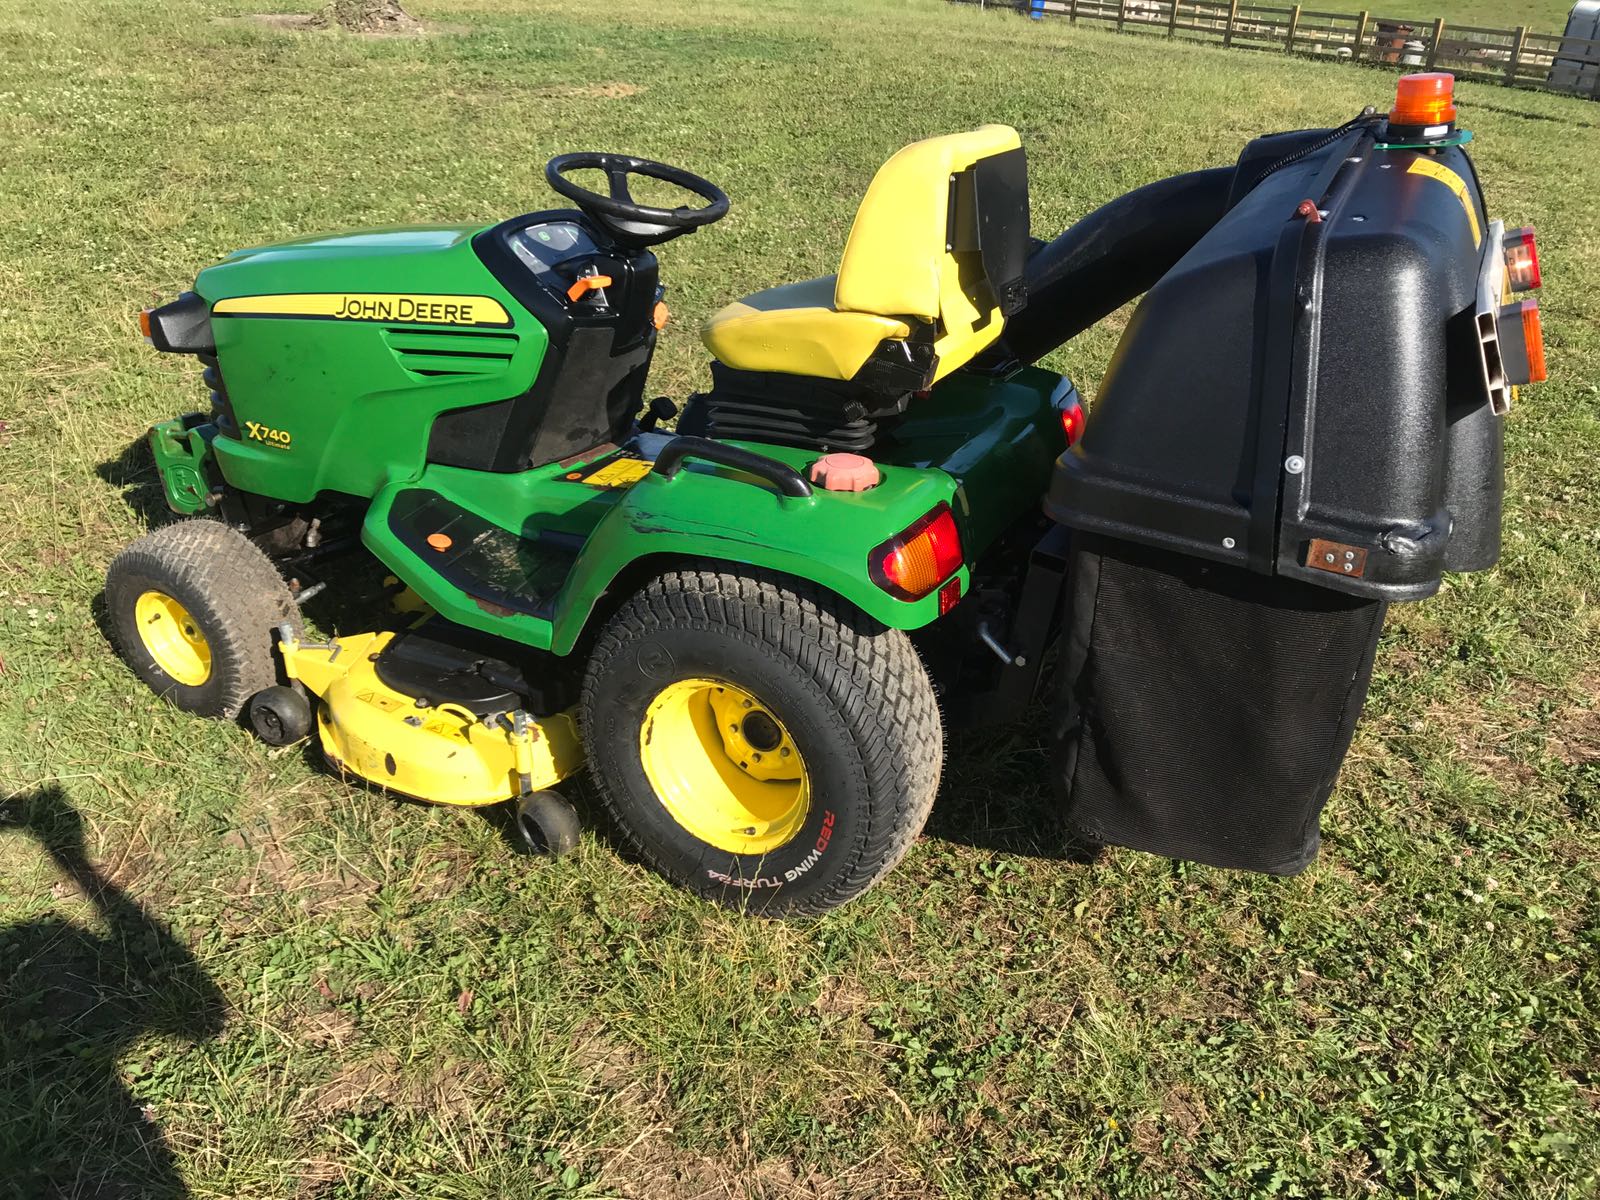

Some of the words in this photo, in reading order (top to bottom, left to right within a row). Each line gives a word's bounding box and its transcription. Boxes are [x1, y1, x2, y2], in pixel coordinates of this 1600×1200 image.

[335, 296, 392, 317] JOHN
[398, 298, 473, 322] DEERE
[245, 421, 291, 443] X740
